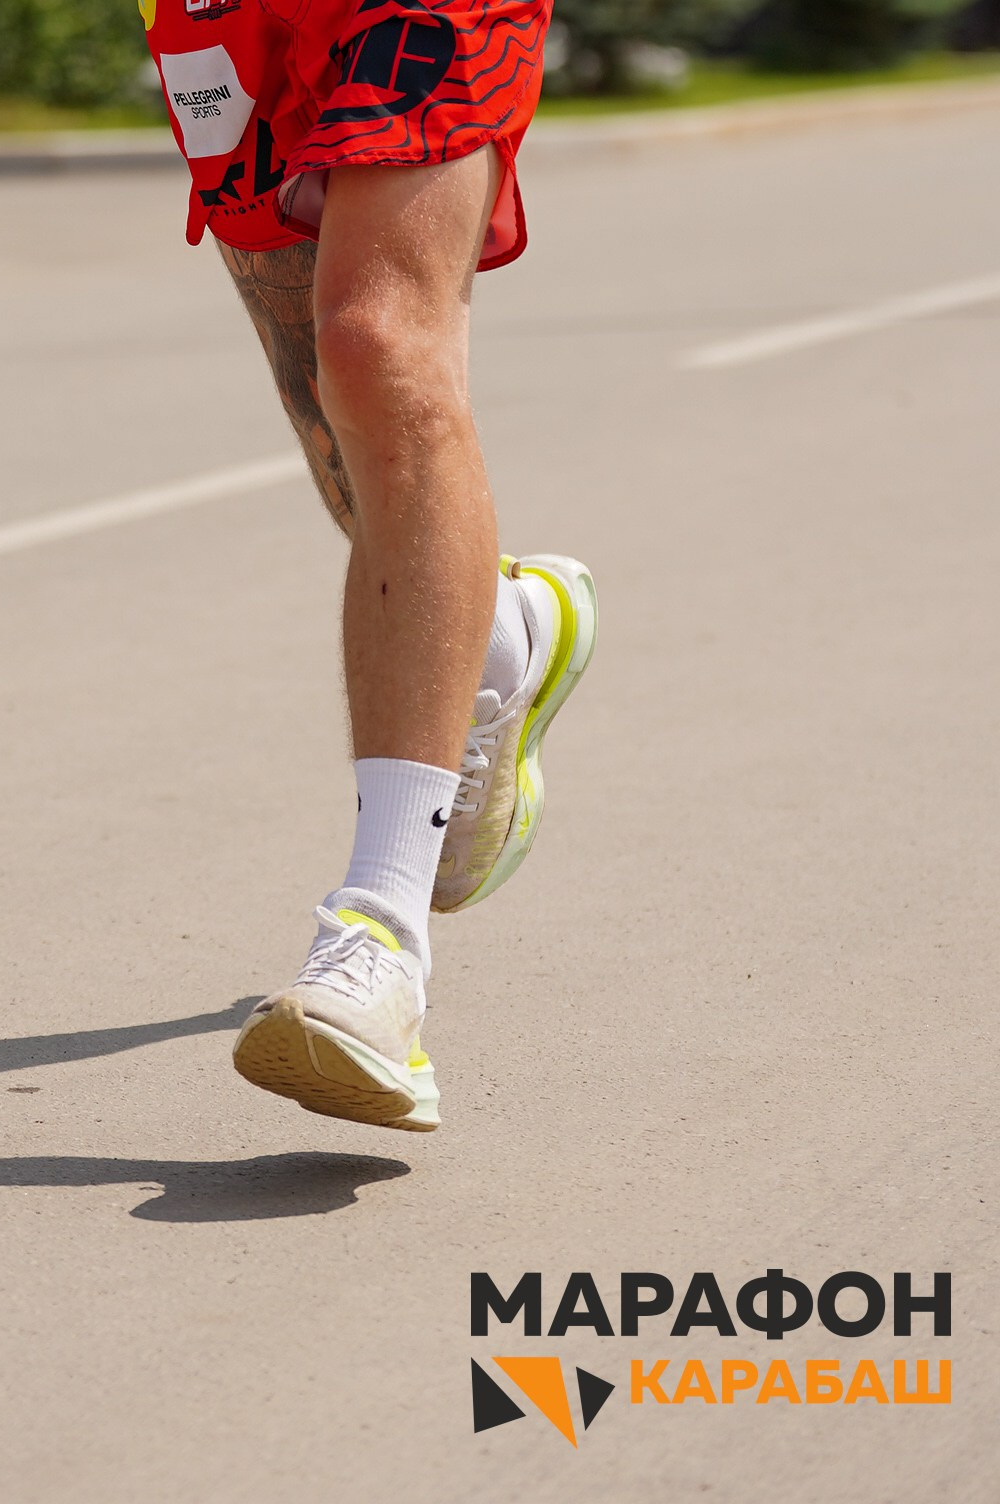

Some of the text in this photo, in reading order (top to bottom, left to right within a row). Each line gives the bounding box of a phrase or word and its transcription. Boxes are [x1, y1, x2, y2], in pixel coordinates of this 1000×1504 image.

[173, 84, 232, 107] PELLEGRINI
[191, 104, 222, 120] SPORTS
[223, 198, 266, 217] FIGHT
